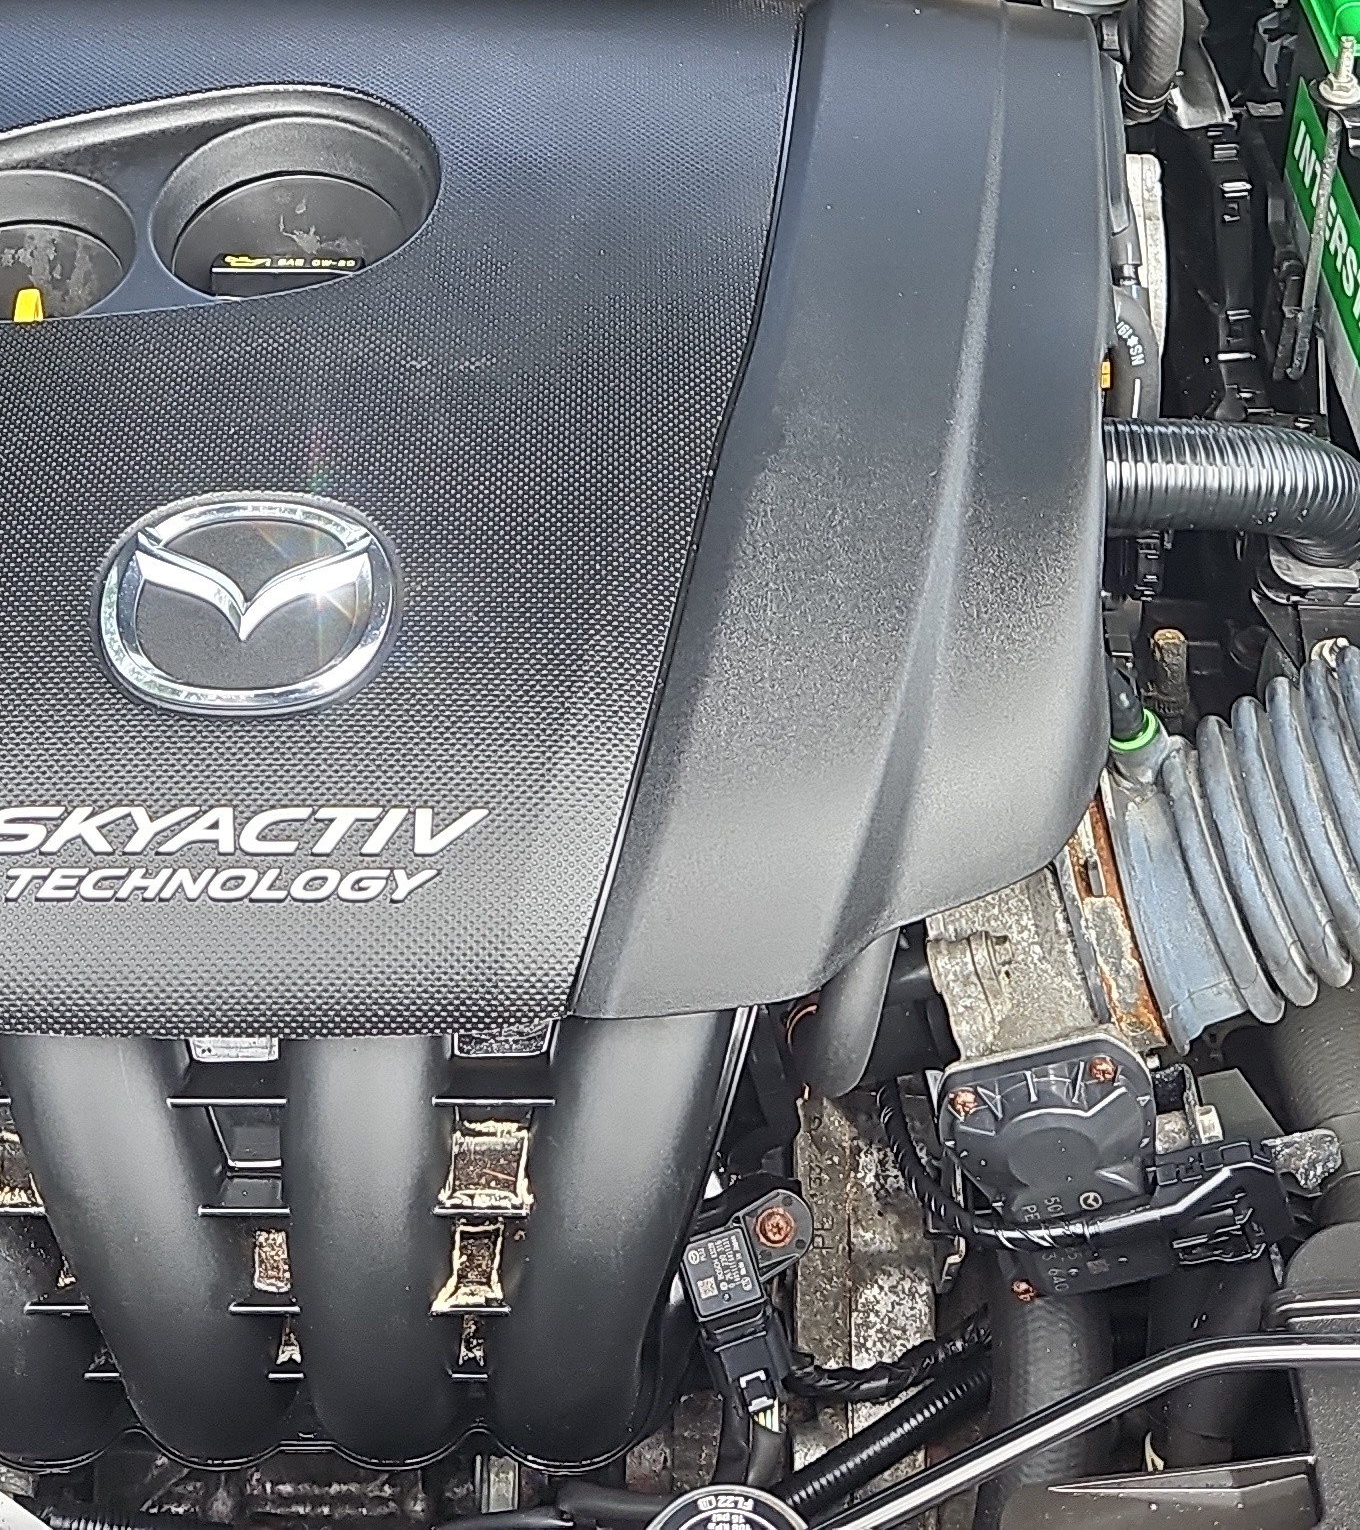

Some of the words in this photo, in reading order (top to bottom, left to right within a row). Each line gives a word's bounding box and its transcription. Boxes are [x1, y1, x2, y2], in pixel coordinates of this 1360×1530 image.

[277, 258, 305, 267] SAE
[5, 867, 440, 904] TECHNOLOGY
[713, 1259, 725, 1281] BOSCH
[716, 1495, 755, 1511] FL22
